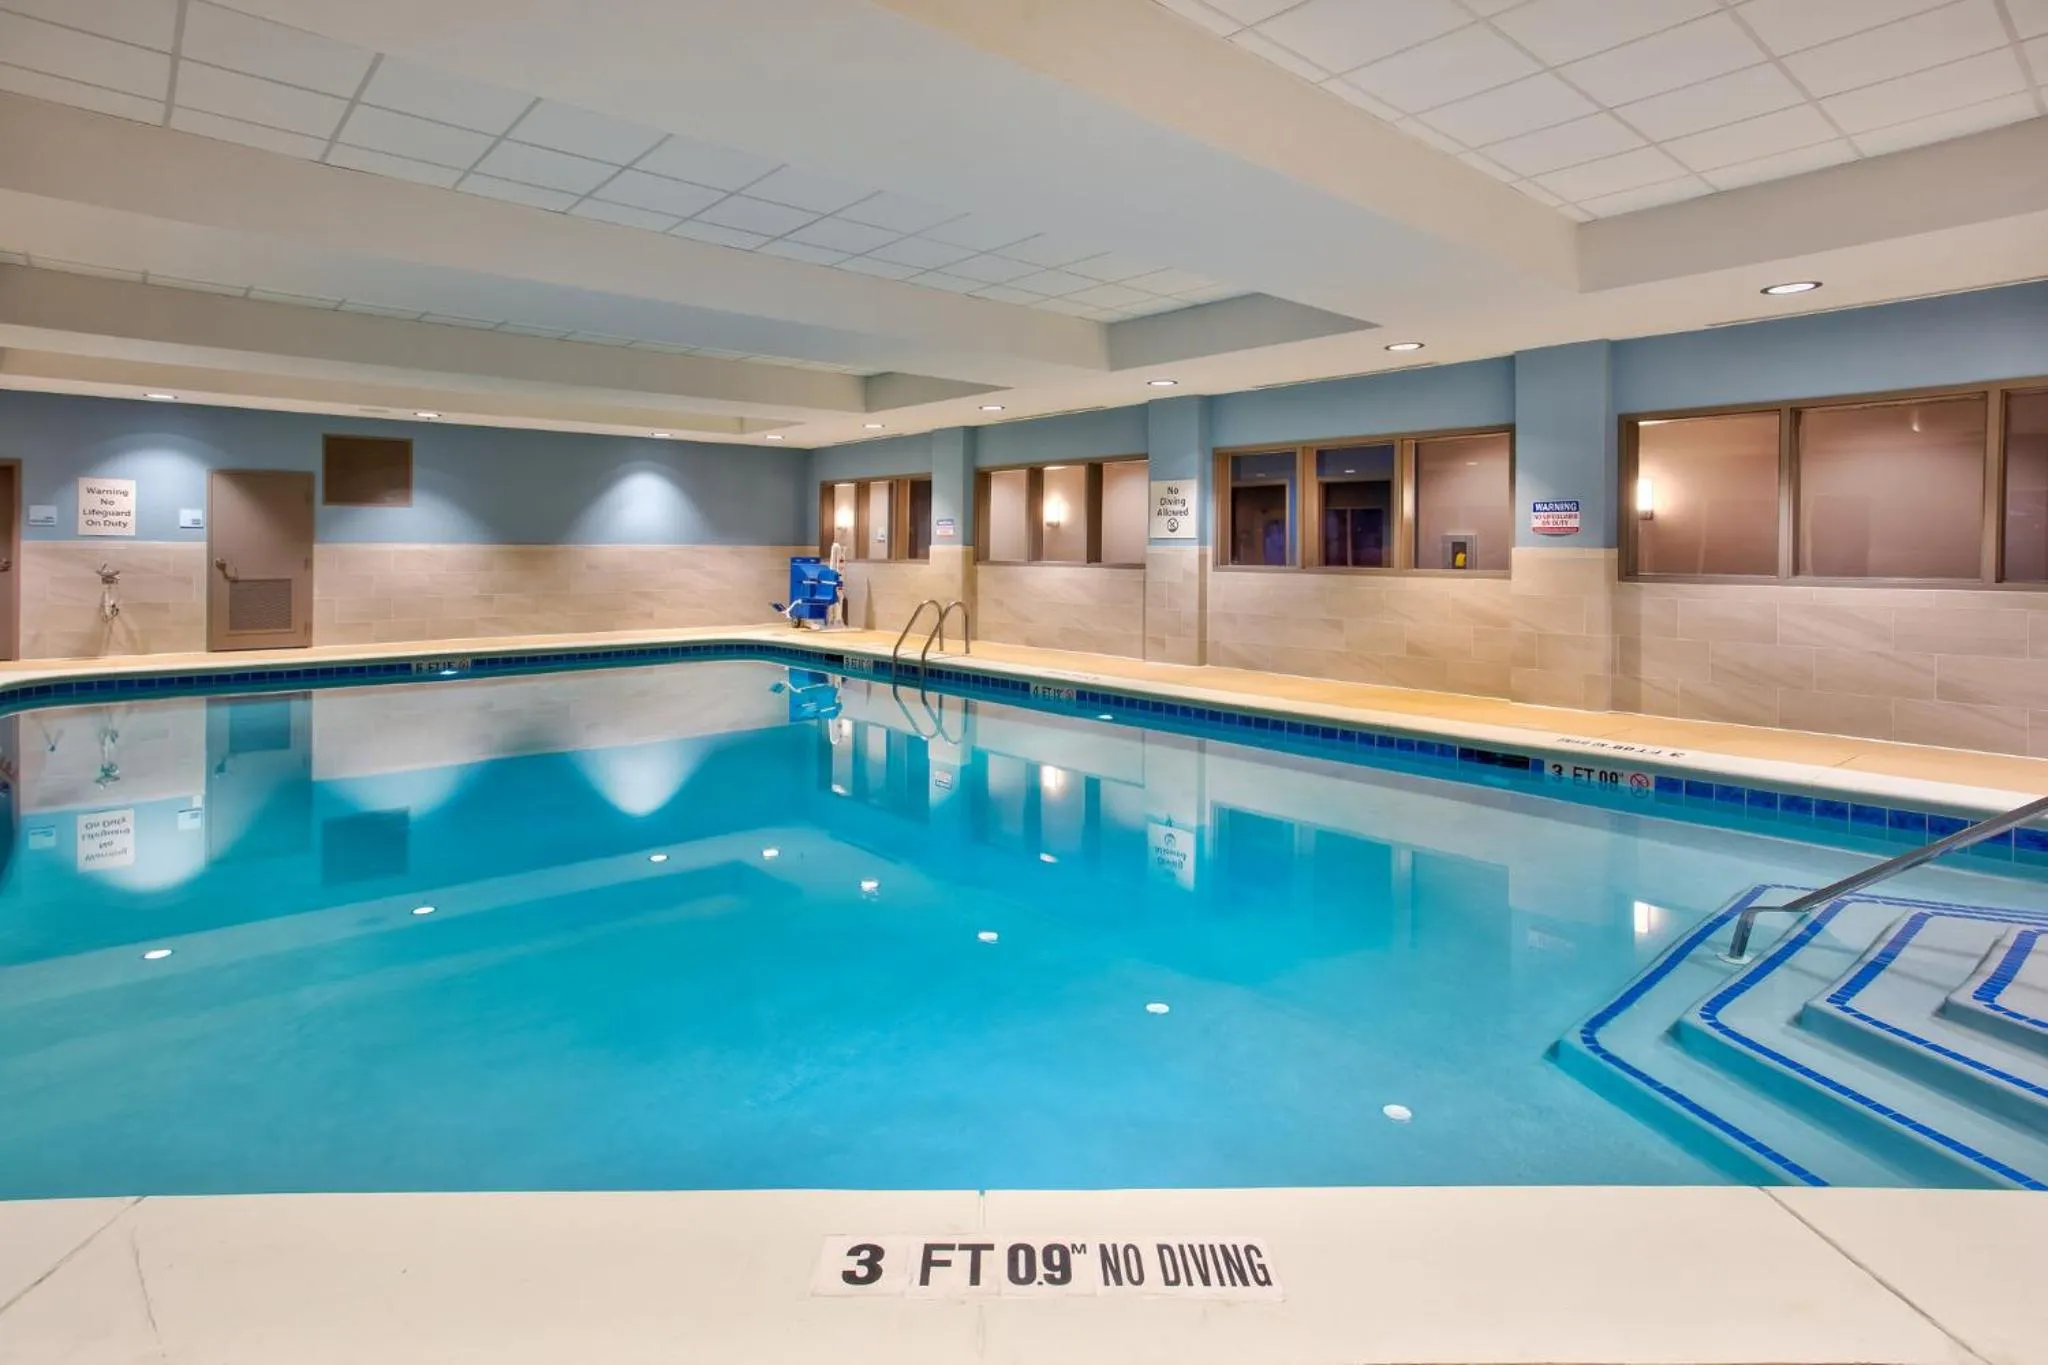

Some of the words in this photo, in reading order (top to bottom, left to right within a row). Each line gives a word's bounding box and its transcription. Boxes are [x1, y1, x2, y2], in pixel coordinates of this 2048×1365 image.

[86, 487, 129, 497] Warning
[1167, 486, 1179, 495] No
[1160, 498, 1185, 507] Diving
[1535, 502, 1577, 511] WARNING
[82, 509, 131, 518] Lifeguard
[1157, 508, 1189, 516] Allowed
[86, 519, 101, 527] On
[103, 519, 128, 528] Duty
[841, 1243, 885, 1286] 3
[918, 1243, 995, 1287] FT
[1099, 1243, 1146, 1287] NO
[1156, 1243, 1273, 1287] DIVING
